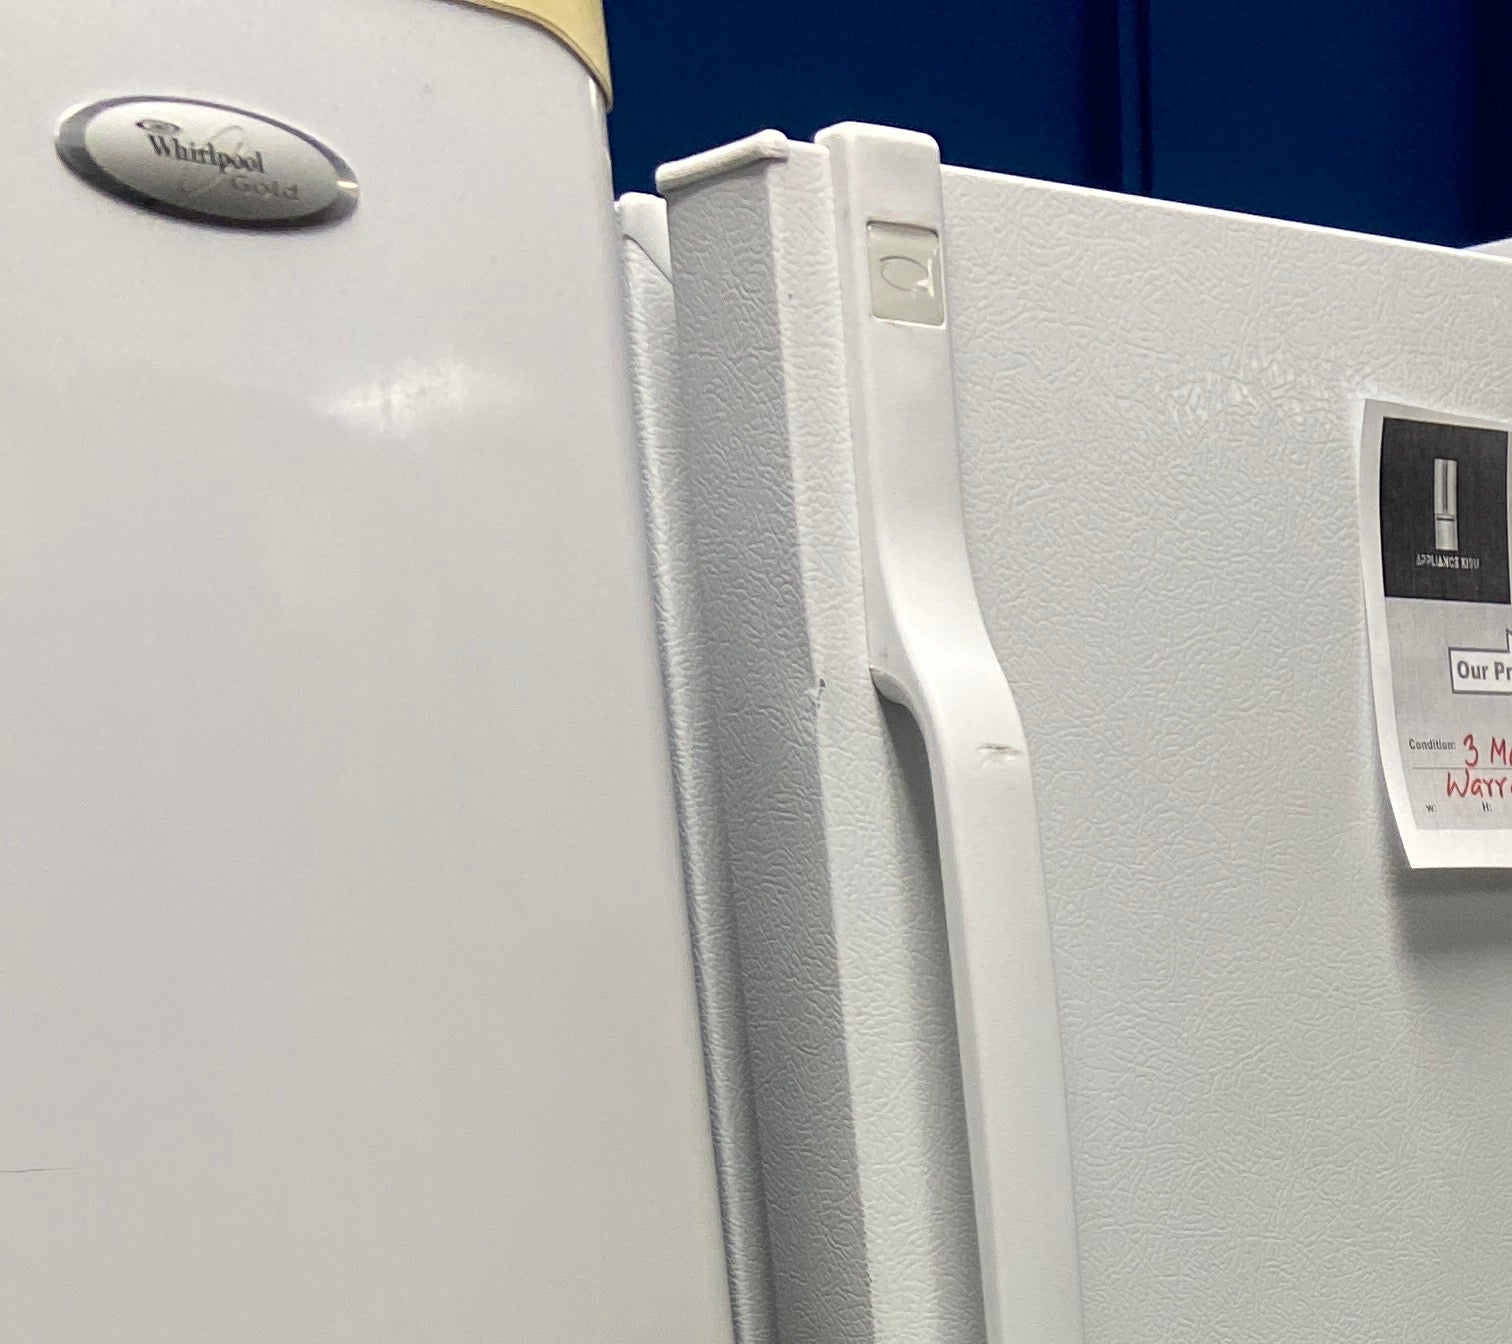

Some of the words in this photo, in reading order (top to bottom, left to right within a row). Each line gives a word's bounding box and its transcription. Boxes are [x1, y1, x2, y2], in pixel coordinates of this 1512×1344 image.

[147, 133, 263, 175] Whirlpool
[1416, 554, 1460, 569] APPLIANCE
[1456, 661, 1489, 681] Our
[1408, 738, 1456, 751] Condition:
[1463, 734, 1479, 767] 3
